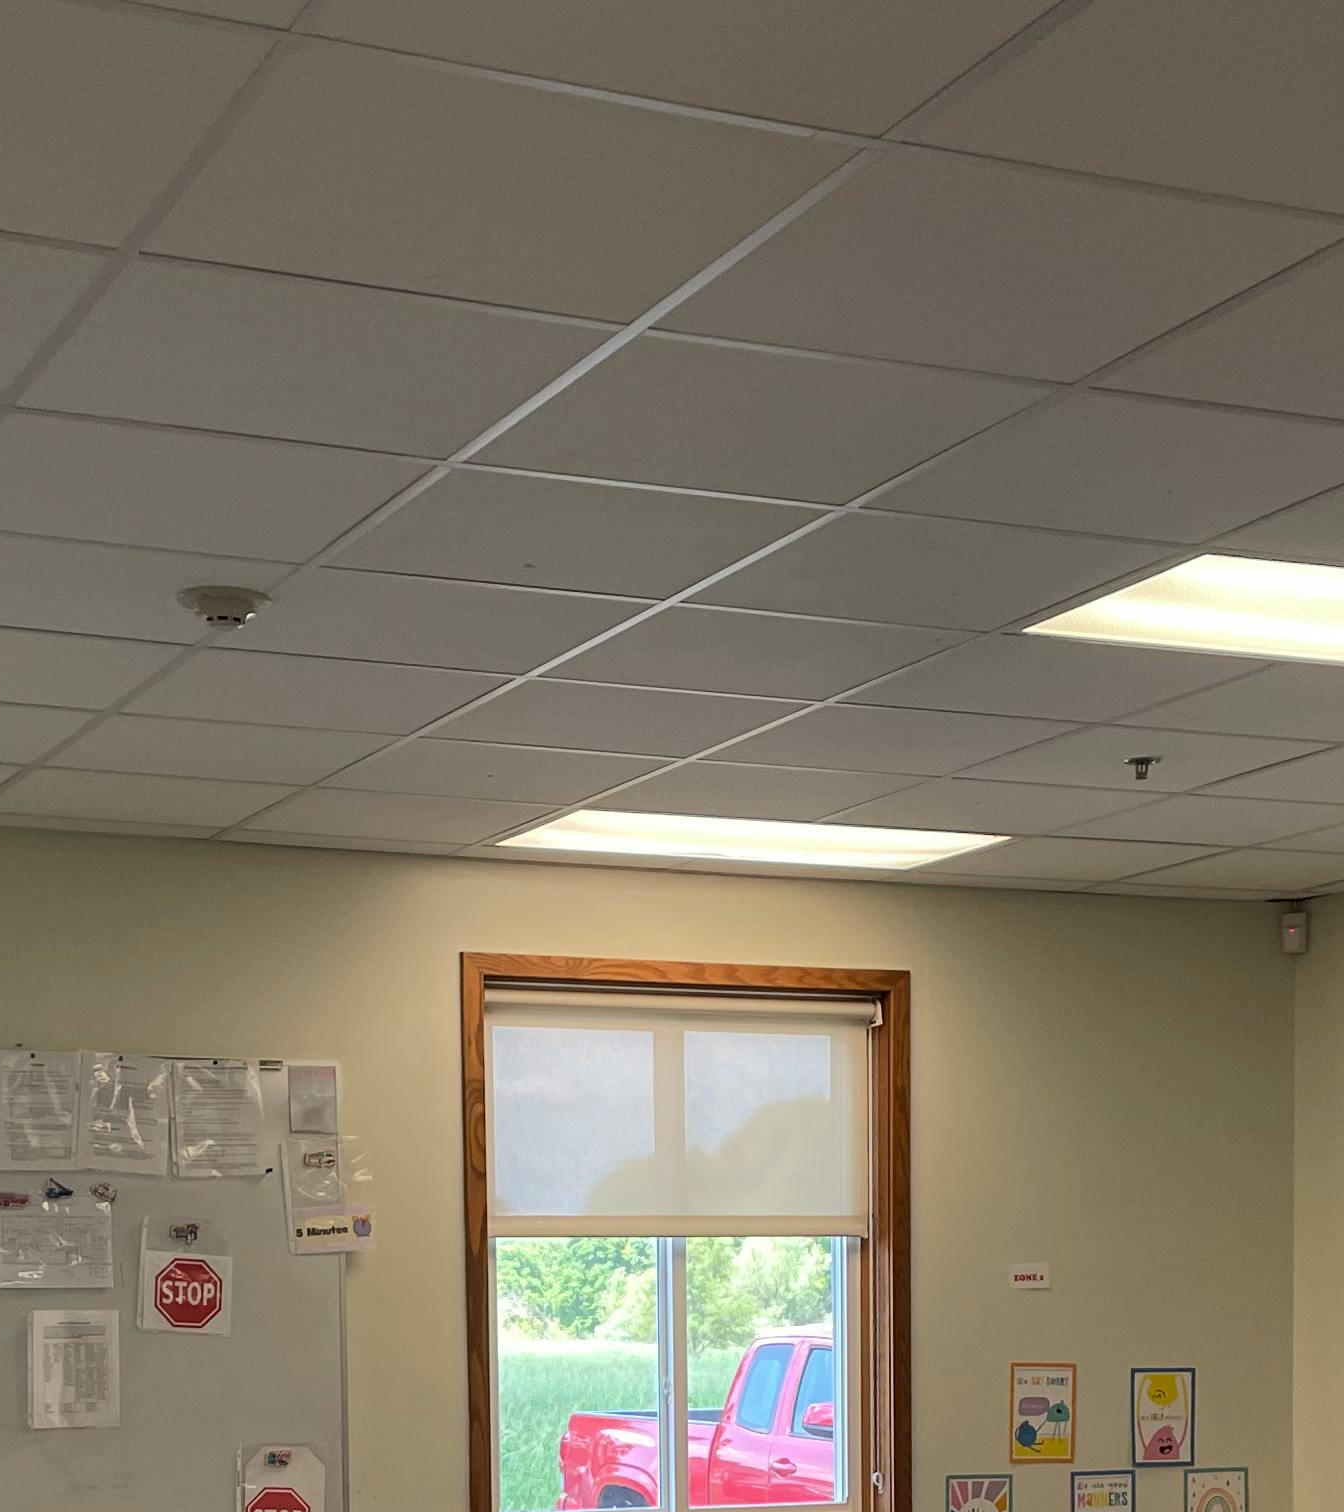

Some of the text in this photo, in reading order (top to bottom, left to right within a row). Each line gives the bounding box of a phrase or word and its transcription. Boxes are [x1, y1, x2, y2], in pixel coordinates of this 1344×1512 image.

[296, 1226, 348, 1238] 5 Minutes
[1013, 1273, 1038, 1281] ZONE
[161, 1281, 215, 1306] STOP
